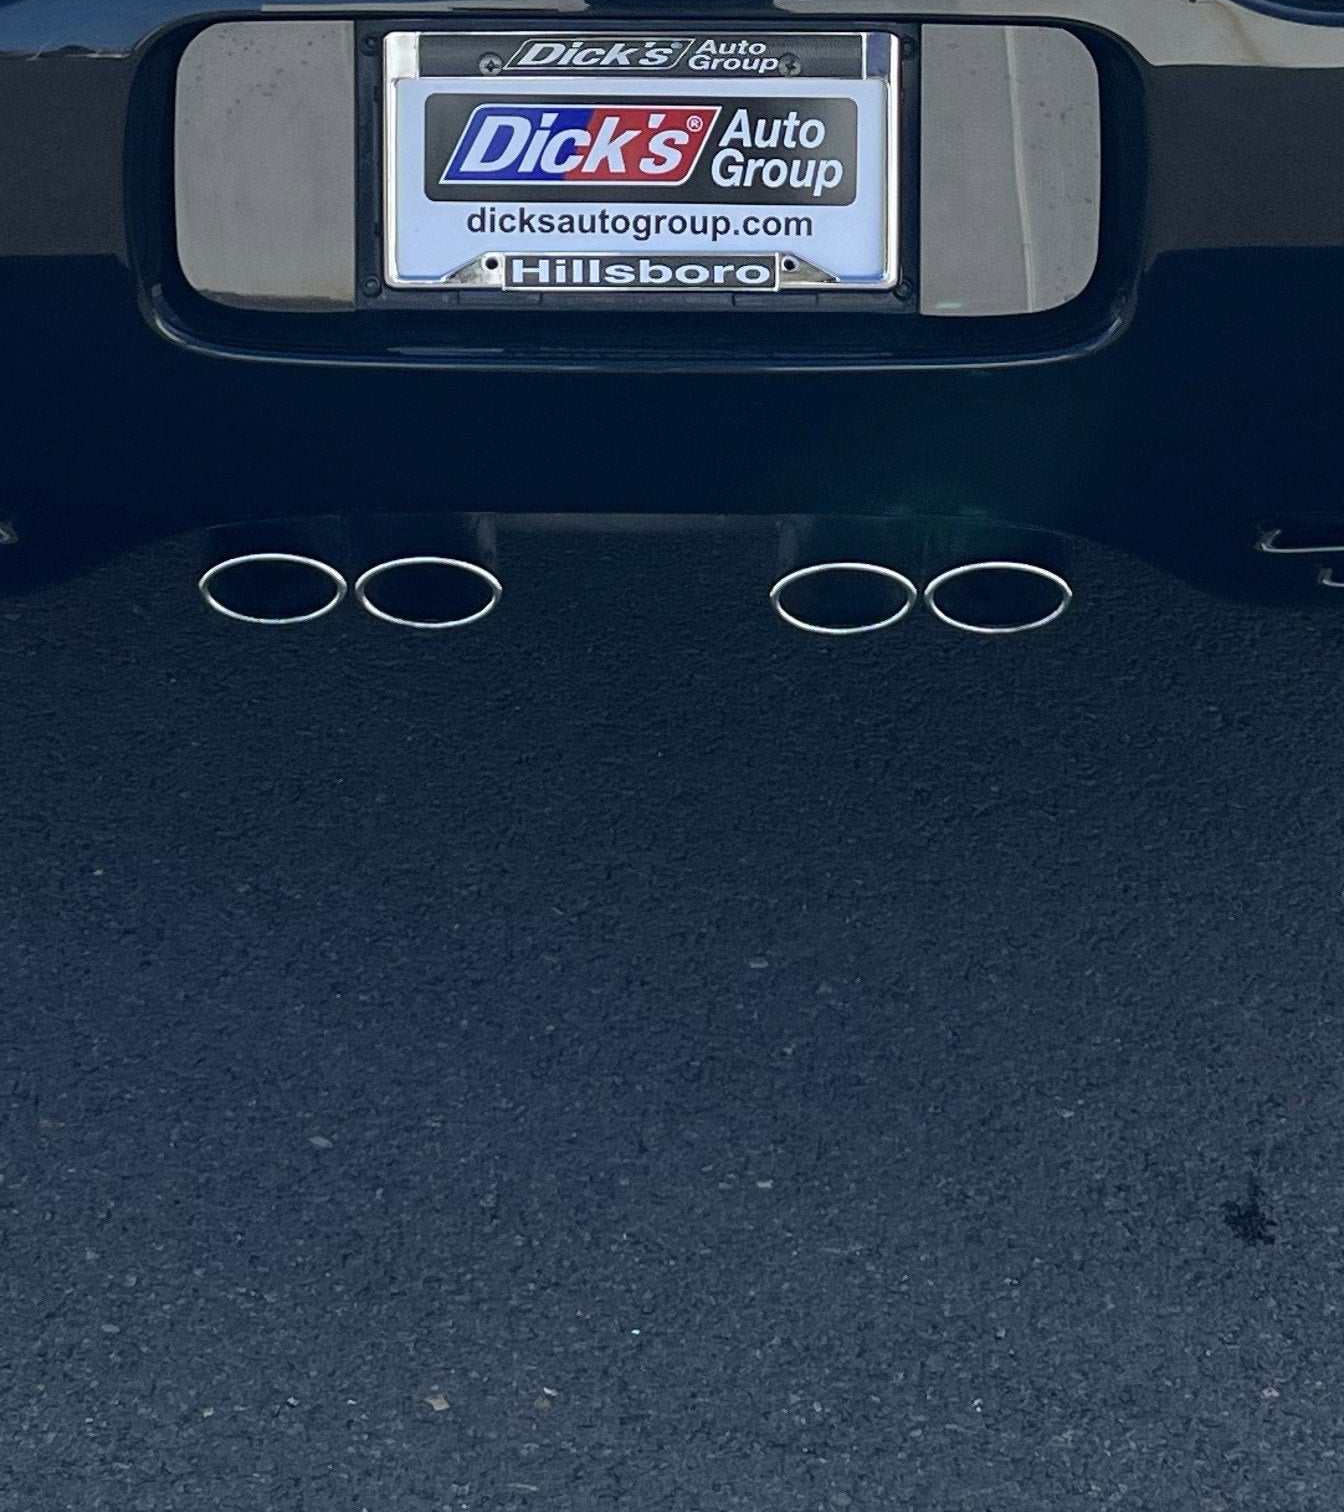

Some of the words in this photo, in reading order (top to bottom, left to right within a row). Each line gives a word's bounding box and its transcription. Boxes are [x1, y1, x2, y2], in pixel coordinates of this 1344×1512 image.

[695, 39, 767, 55] Auto
[688, 54, 779, 74] Group
[718, 108, 827, 150] Auto
[711, 148, 844, 197] Group
[466, 206, 814, 242] dicksautogroup.com
[511, 258, 771, 285] Hillsboro
